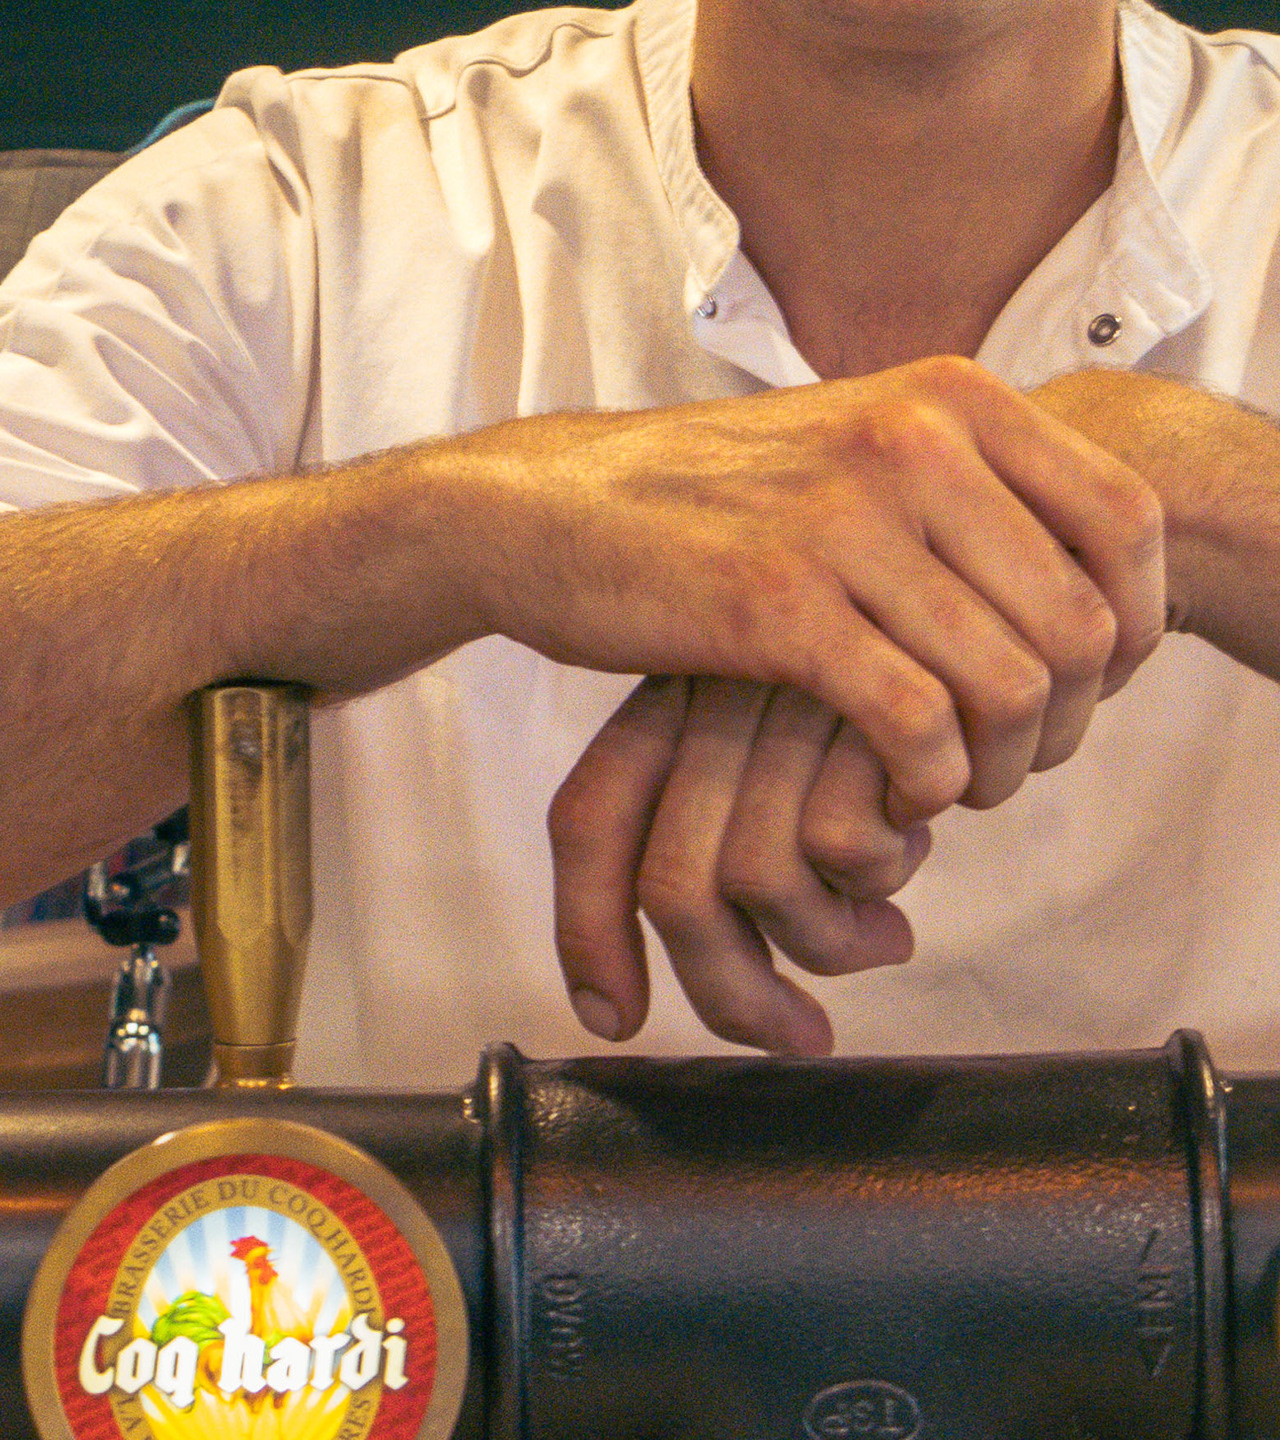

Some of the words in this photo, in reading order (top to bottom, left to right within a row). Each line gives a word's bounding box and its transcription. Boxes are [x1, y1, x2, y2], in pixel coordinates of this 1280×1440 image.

[113, 1188, 210, 1320] BRASSERIE
[219, 1179, 261, 1201] DU
[269, 1184, 327, 1238] COQ
[79, 1315, 199, 1409] Coq
[218, 1313, 409, 1394] hardi
